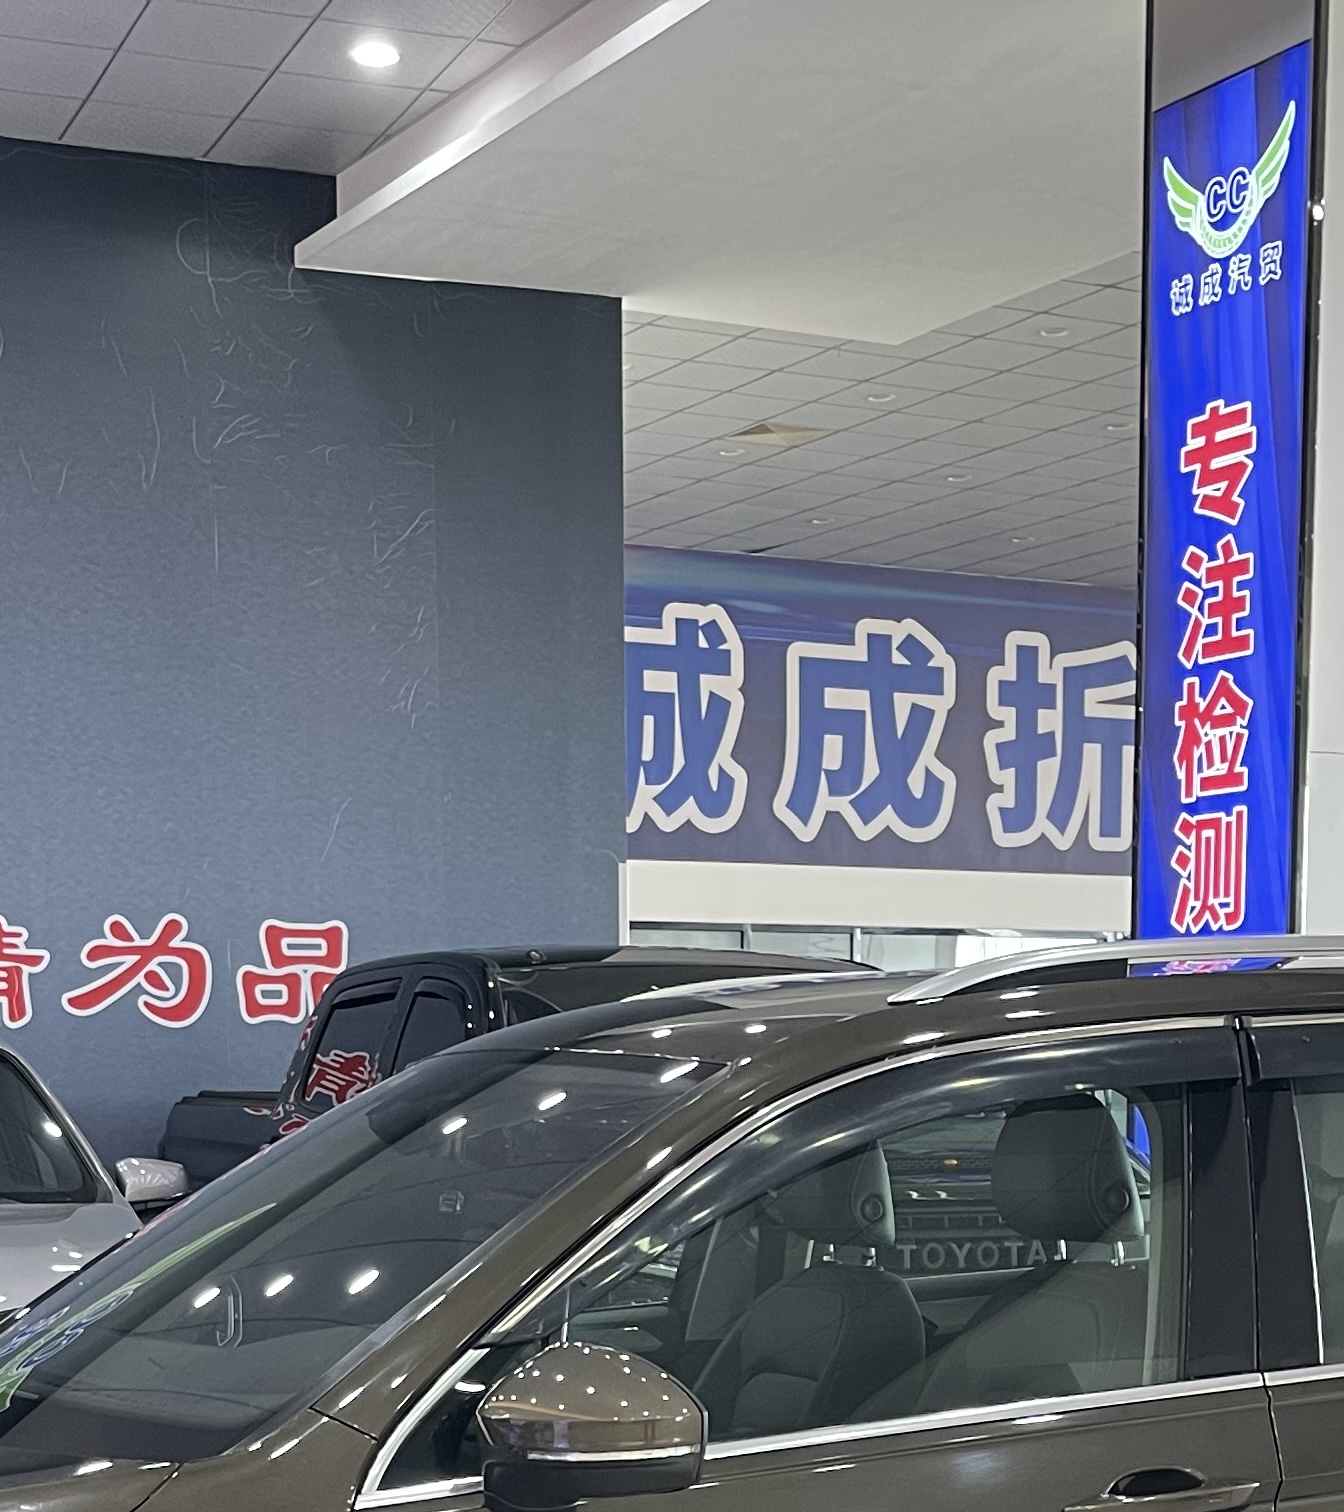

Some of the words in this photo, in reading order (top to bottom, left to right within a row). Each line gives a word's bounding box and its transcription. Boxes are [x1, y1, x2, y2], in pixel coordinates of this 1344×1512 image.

[1205, 166, 1253, 222] CC
[1170, 398, 1256, 934] 专注检测
[895, 1239, 1048, 1269] TOYOTA
